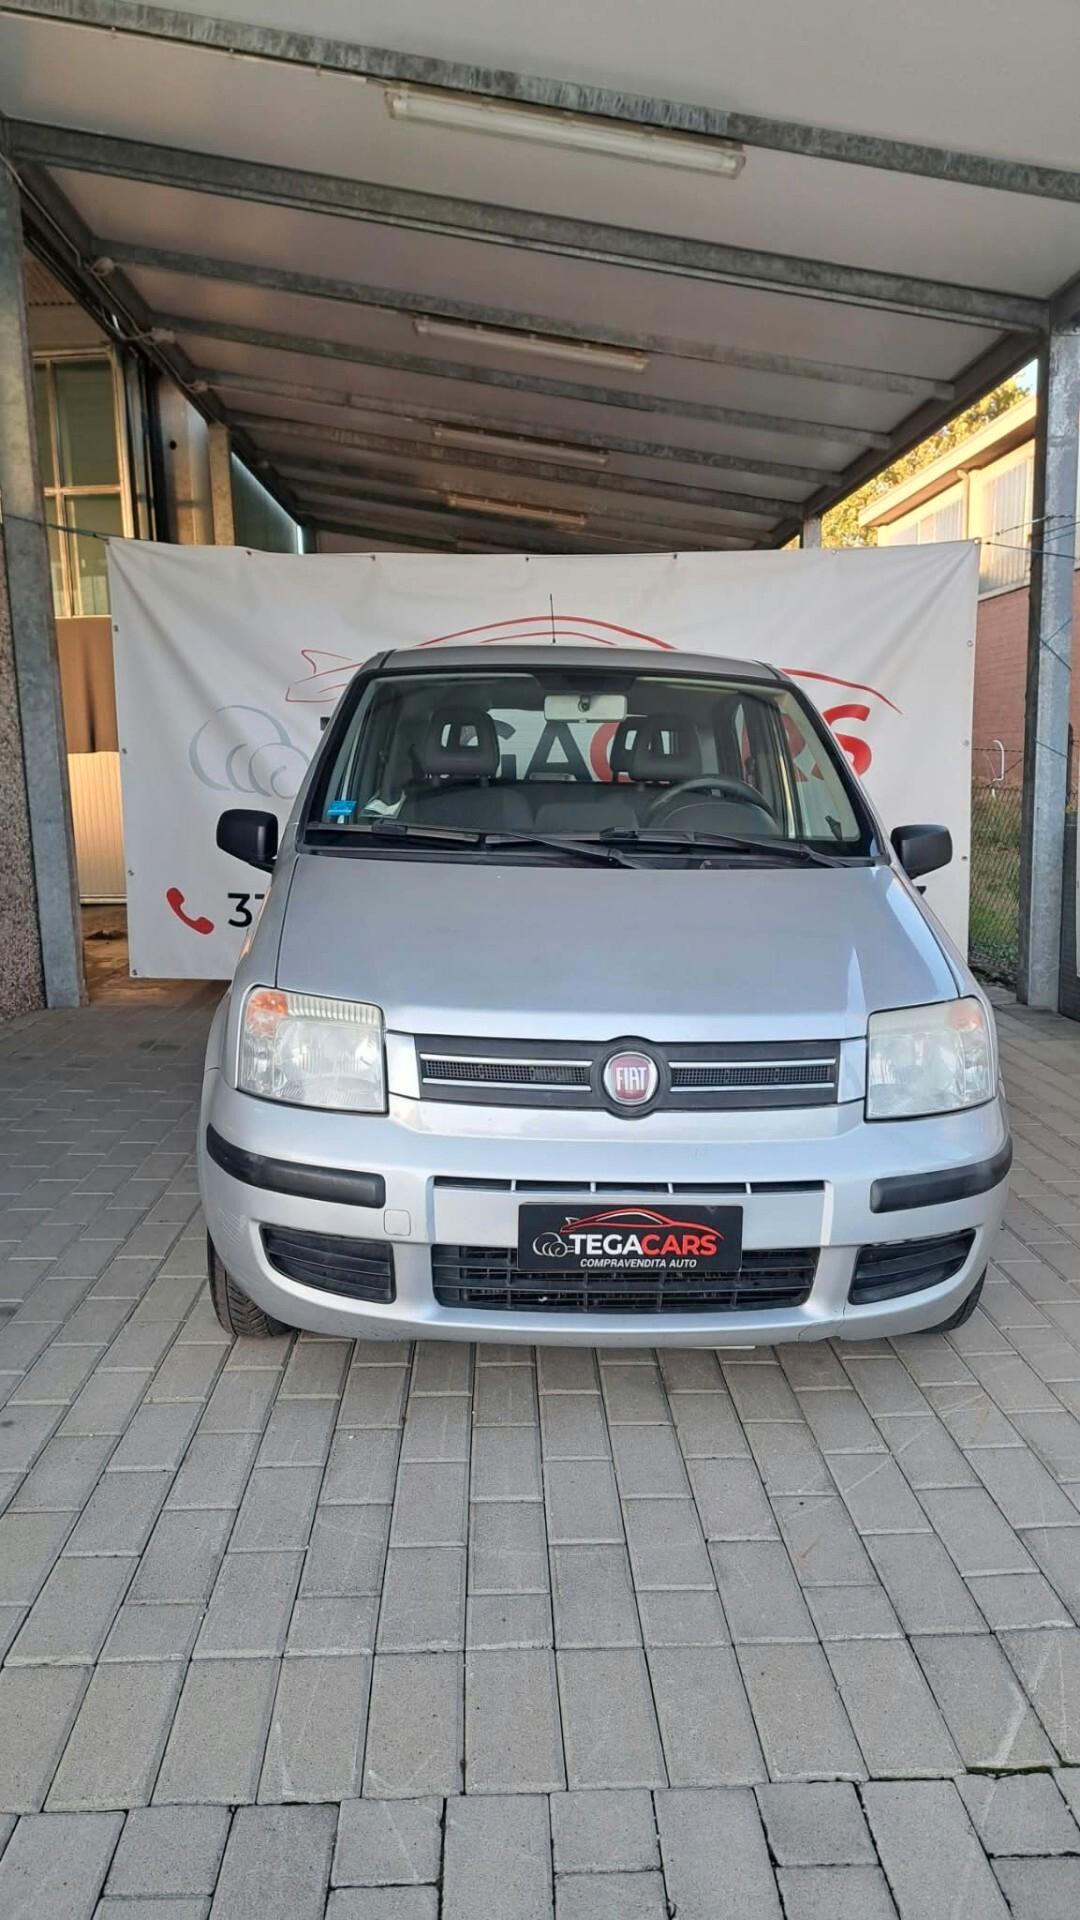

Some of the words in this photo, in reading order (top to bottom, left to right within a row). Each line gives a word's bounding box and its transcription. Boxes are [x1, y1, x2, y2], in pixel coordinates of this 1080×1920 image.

[615, 1066, 647, 1091] FIAT
[569, 1234, 718, 1256] TEGACARS
[579, 1258, 667, 1269] COMPRAVENDITA
[668, 1258, 697, 1269] AUTO
